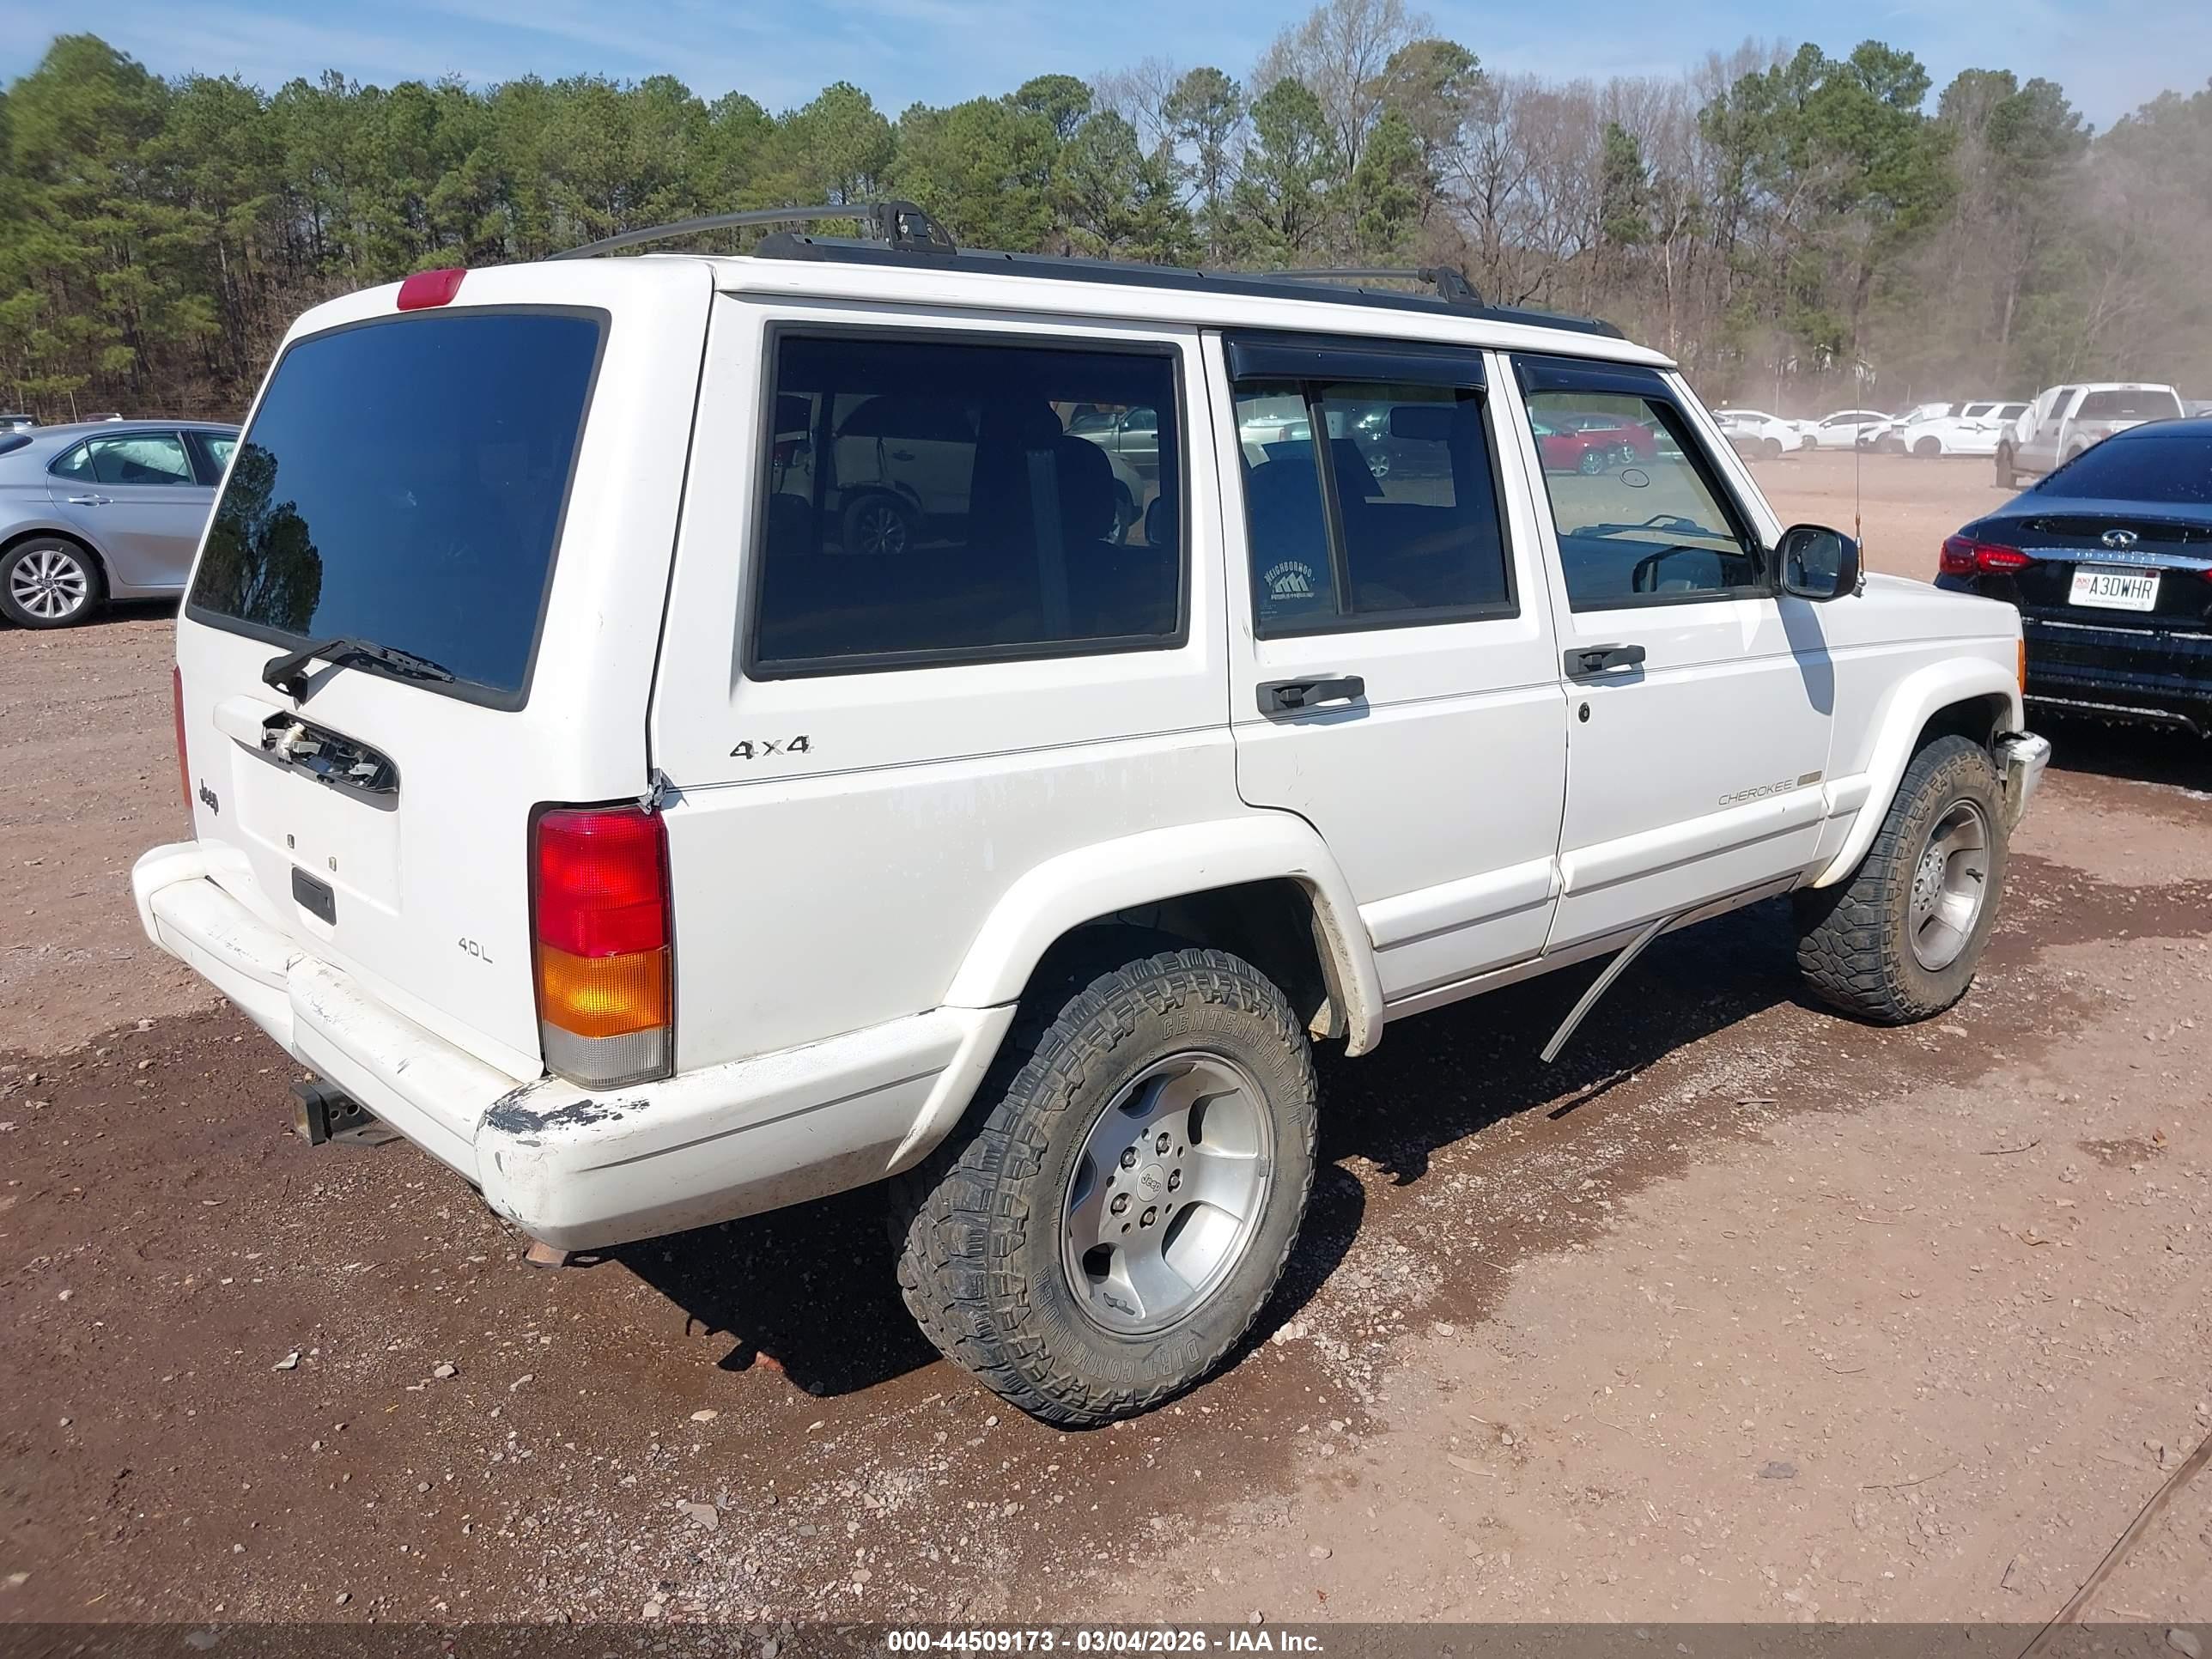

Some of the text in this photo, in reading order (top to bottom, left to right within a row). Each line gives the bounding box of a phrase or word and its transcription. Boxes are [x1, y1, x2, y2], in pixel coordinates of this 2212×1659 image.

[1264, 561, 1316, 587] NEIGHBORHOO
[2089, 576, 2154, 599] A3DWHR
[199, 778, 220, 817] Jeep
[1717, 779, 1794, 805] CHEROKEE
[1161, 1008, 1292, 1079] CENTENNIAL
[1141, 1173, 1162, 1193] Jeep
[1031, 1266, 1200, 1383] DIRT COMMANDER
